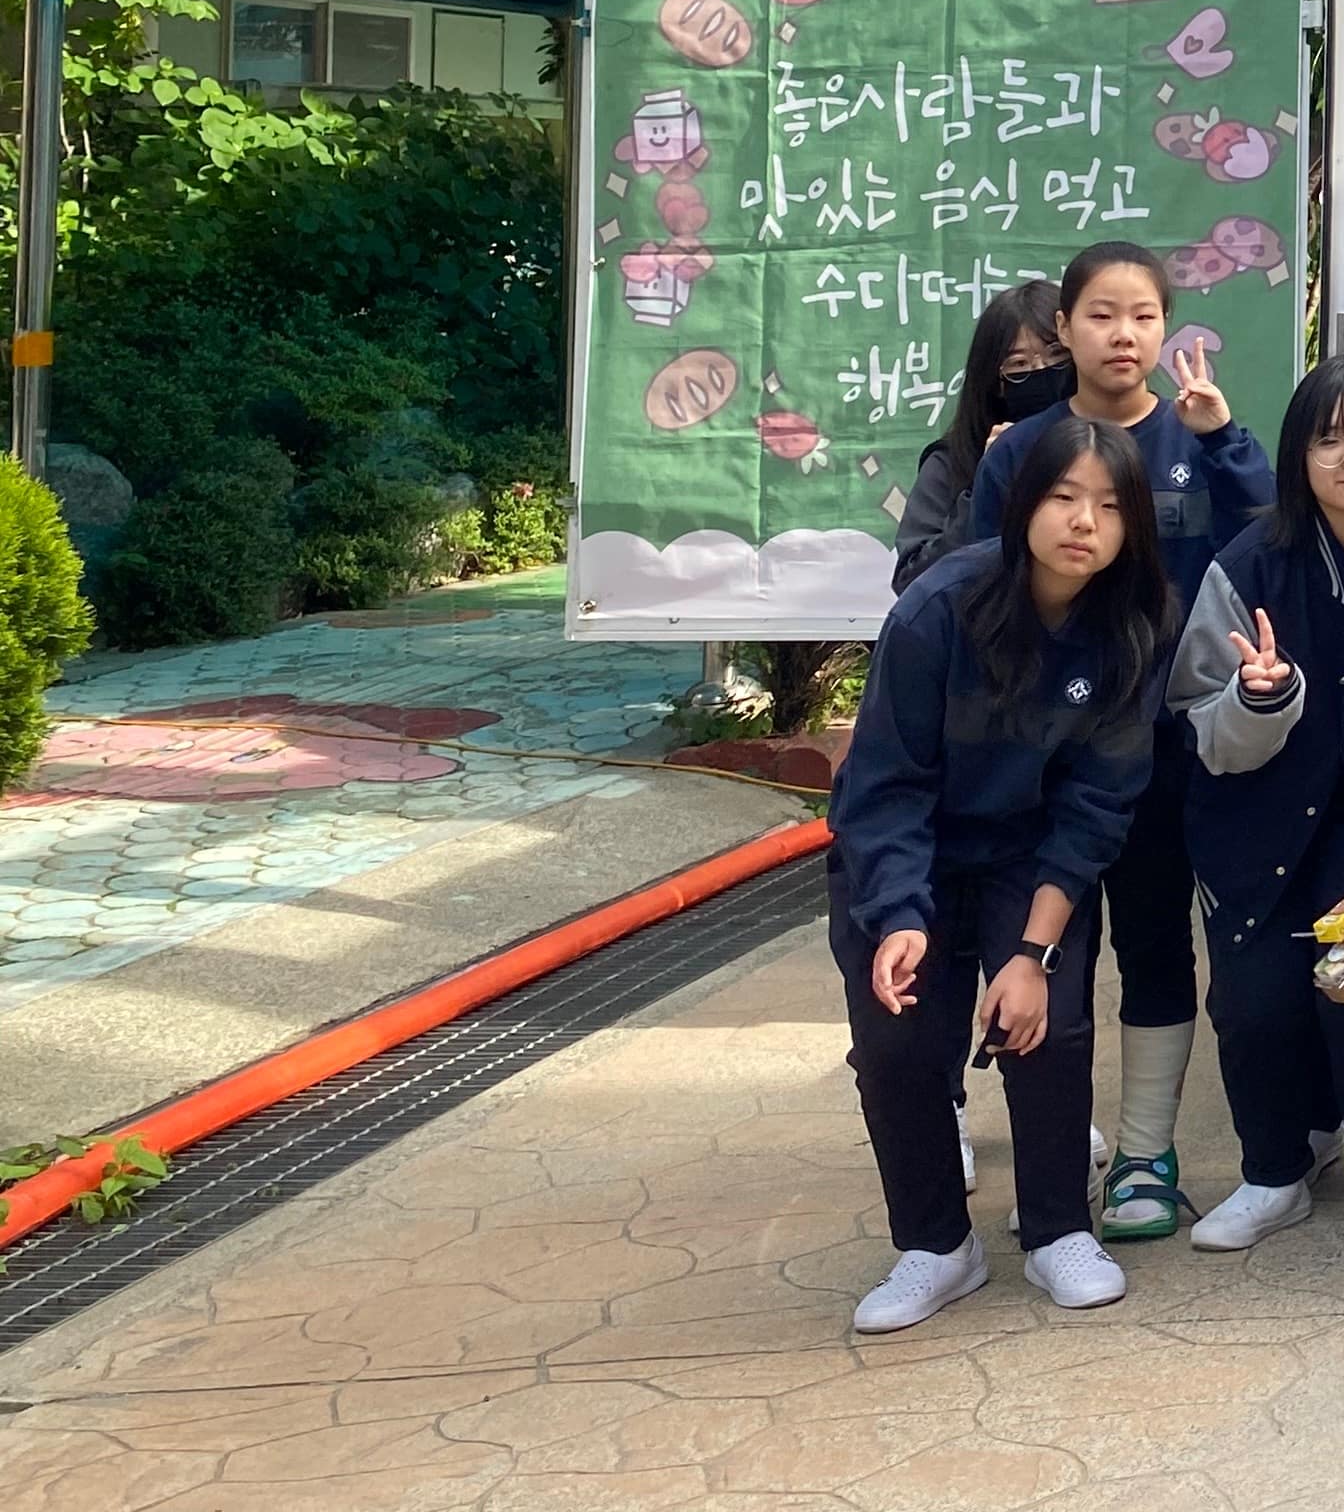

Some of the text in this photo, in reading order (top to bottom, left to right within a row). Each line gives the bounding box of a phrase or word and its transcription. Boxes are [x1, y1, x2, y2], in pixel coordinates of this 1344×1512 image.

[740, 154, 1150, 241] 맛있는 음식 먹고
[801, 253, 1063, 325] 수다떠는
[836, 341, 966, 427] 행복
